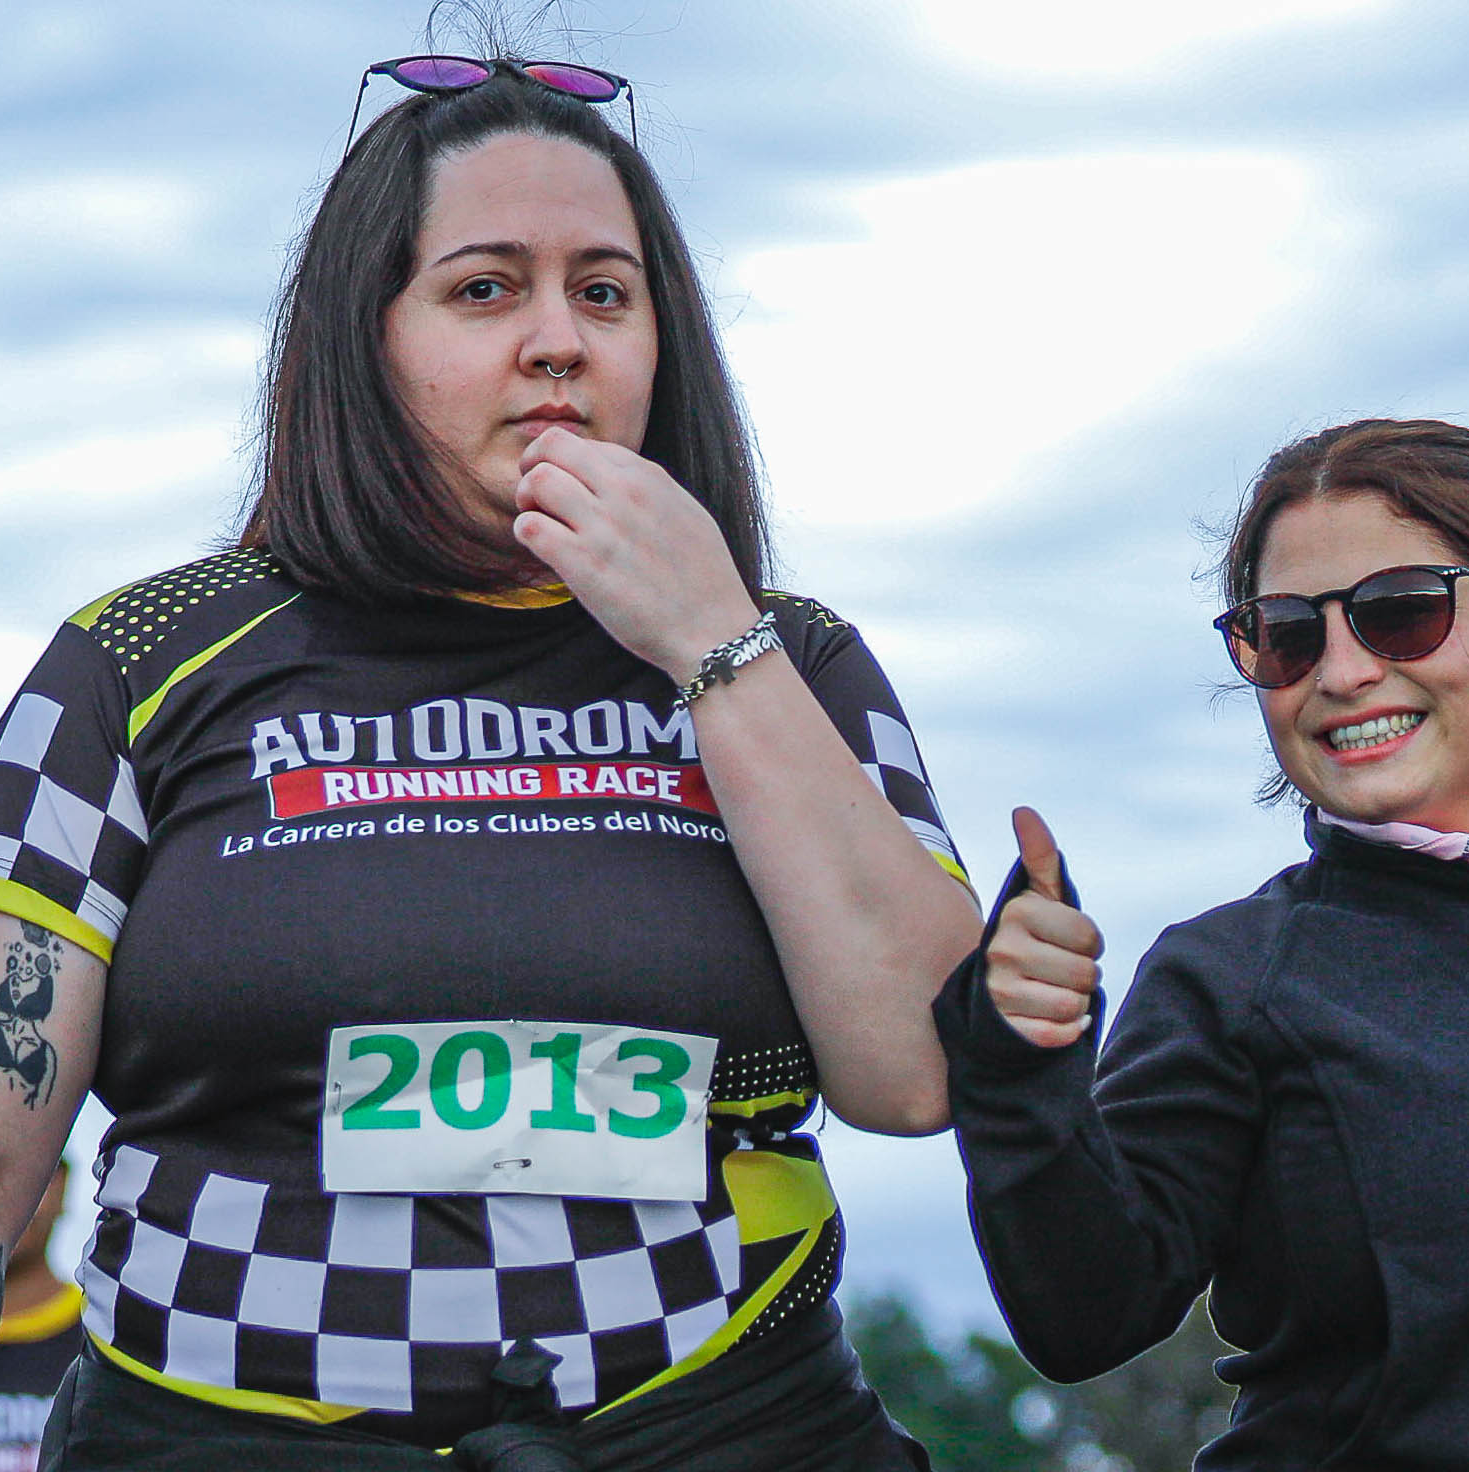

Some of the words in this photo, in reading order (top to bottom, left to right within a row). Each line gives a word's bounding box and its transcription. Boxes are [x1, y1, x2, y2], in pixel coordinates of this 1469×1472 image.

[250, 697, 699, 780] AUTODROM
[323, 767, 542, 806] RUNNING
[557, 766, 682, 803] RACE
[221, 835, 254, 857] La
[262, 819, 376, 847] Carrera
[385, 814, 425, 834] de
[435, 813, 480, 834] los
[487, 813, 596, 833] Clubes
[603, 811, 652, 832] del
[658, 814, 731, 843] Noro
[342, 1030, 691, 1139] 2013
